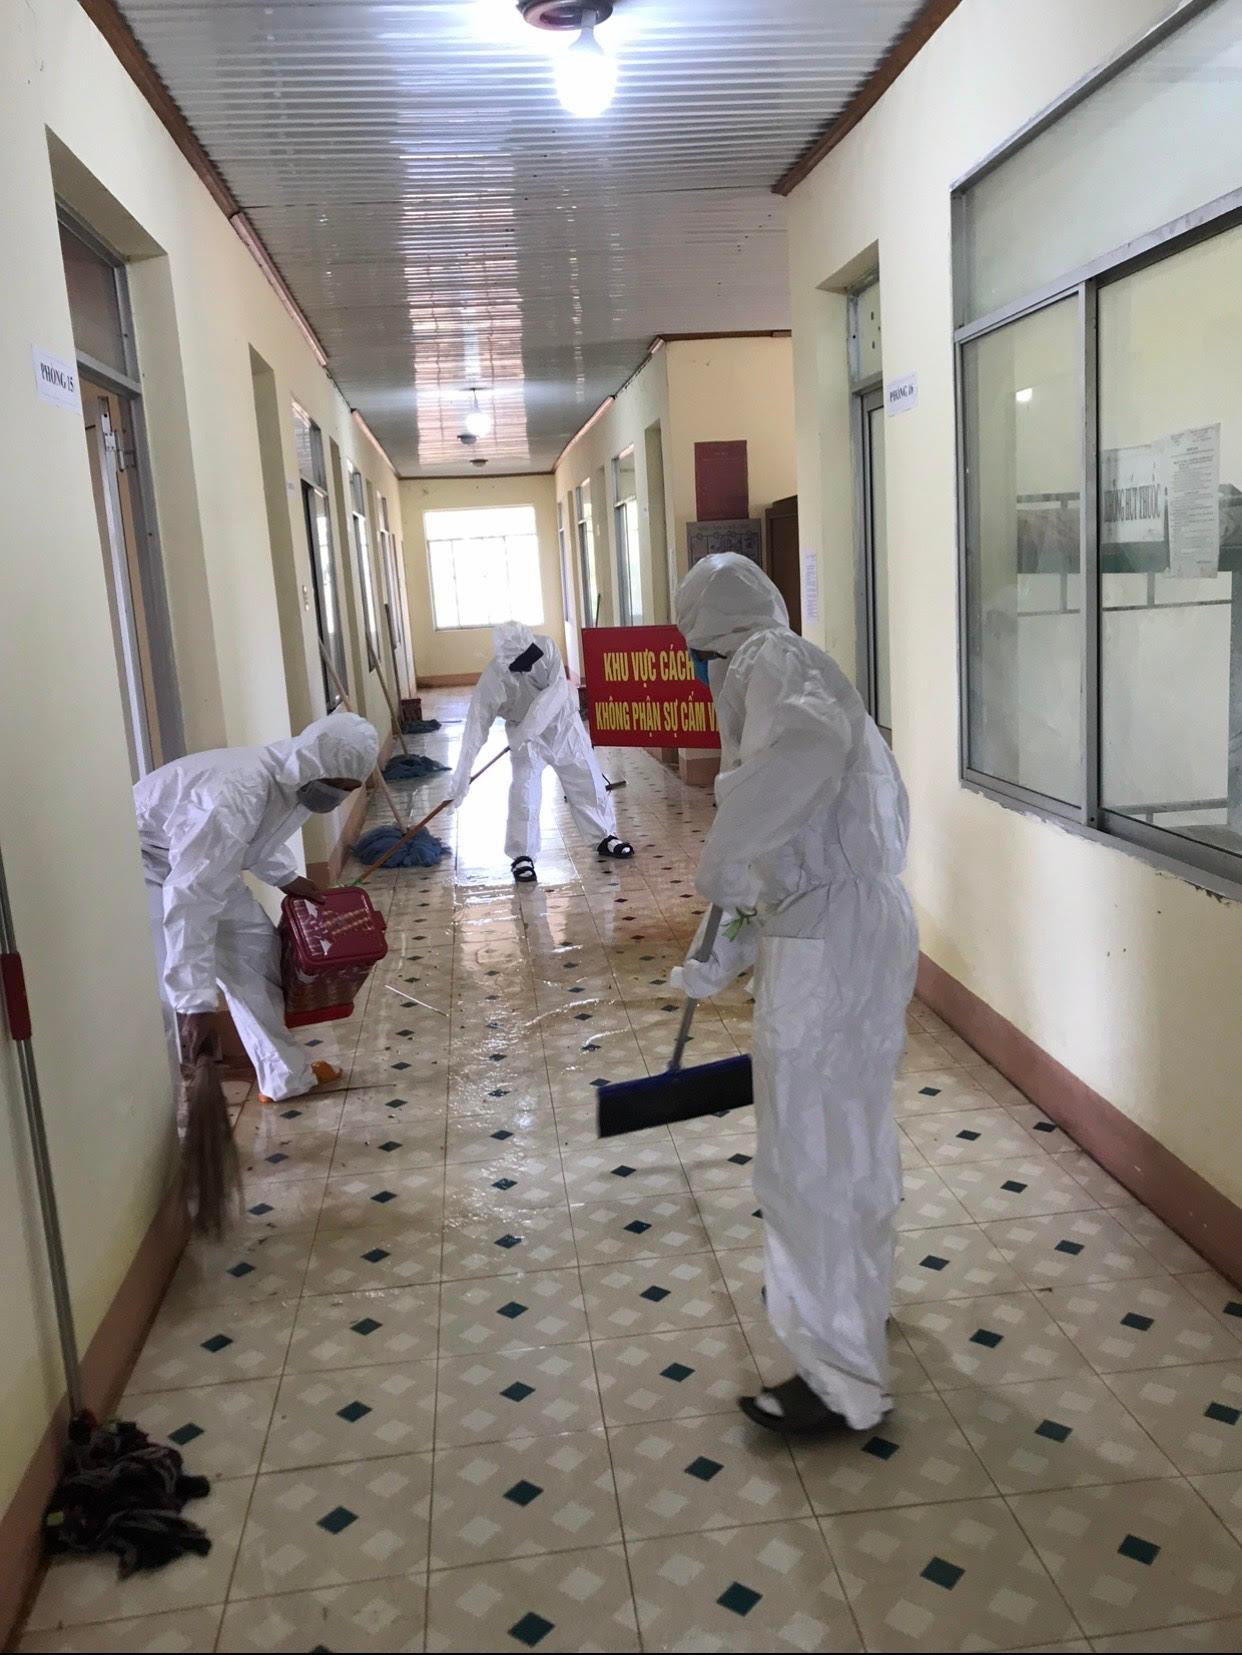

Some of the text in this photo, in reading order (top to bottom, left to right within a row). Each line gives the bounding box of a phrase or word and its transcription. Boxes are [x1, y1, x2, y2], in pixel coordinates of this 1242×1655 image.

[67, 375, 74, 392] 15
[603, 643, 695, 688] KHU VỰC CÁCH
[595, 695, 630, 731] KHÔNG
[632, 695, 661, 738] PHẬN
[663, 698, 679, 738] SỰ
[680, 690, 706, 732] CẤM
